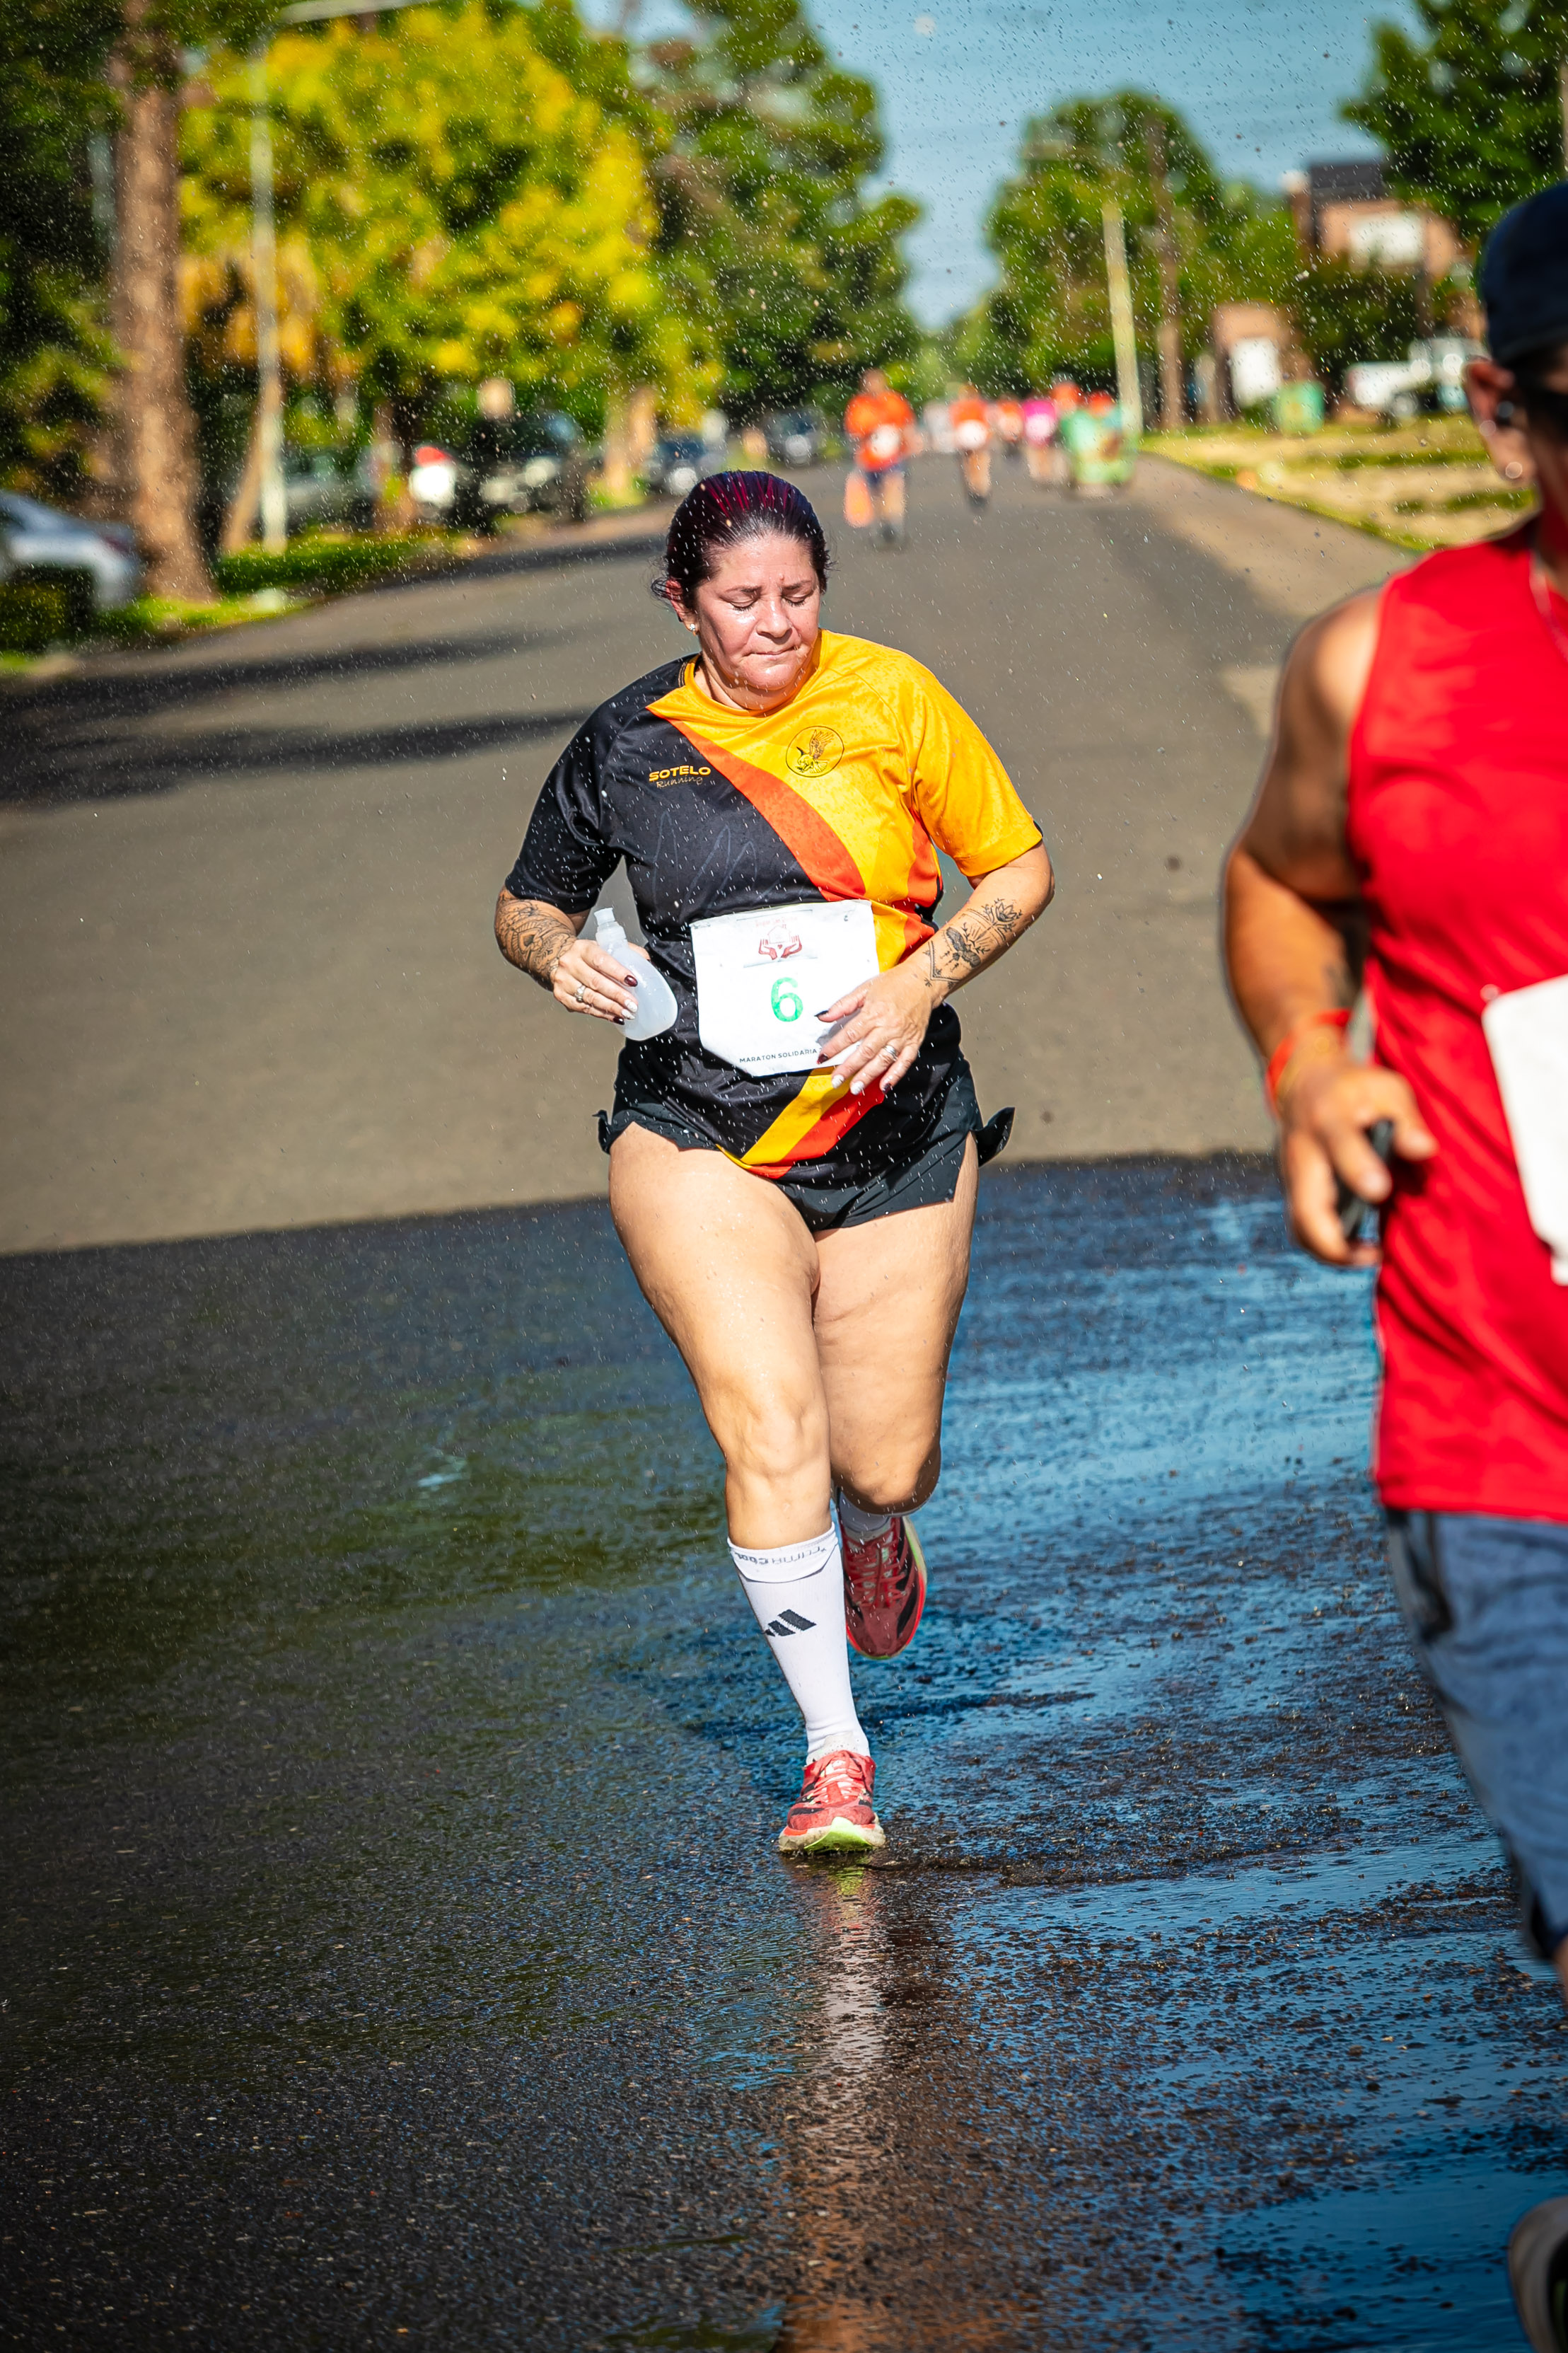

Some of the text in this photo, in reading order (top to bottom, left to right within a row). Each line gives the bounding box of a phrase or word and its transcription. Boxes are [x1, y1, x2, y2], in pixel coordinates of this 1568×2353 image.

[649, 765, 711, 782] SOTELO
[656, 775, 703, 788] Running
[771, 977, 803, 1022] 6
[739, 1054, 777, 1063] MARATON
[778, 1048, 818, 1058] SOLIDARIA
